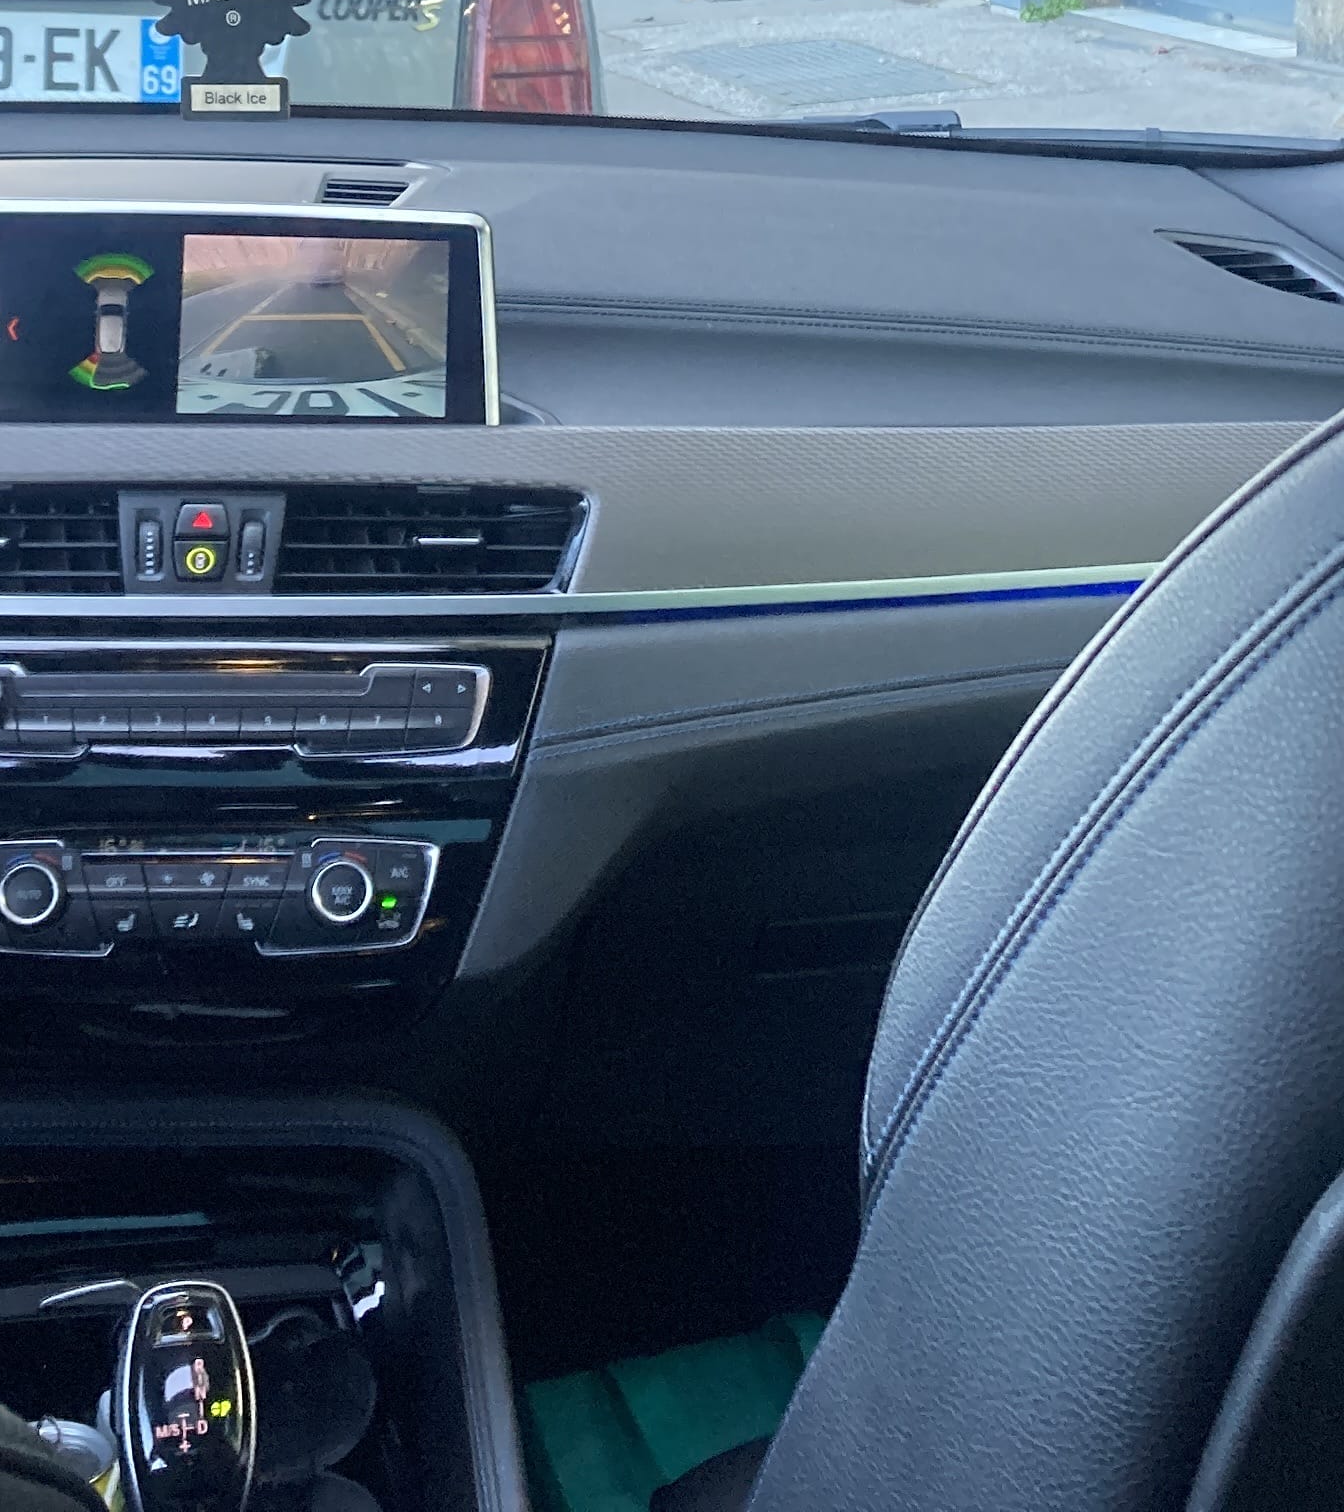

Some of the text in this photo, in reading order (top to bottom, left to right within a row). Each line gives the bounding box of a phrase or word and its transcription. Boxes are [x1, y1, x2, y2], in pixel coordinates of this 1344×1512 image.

[142, 64, 178, 95] 69
[205, 91, 268, 105] Black Ice
[197, 1419, 209, 1435] D
